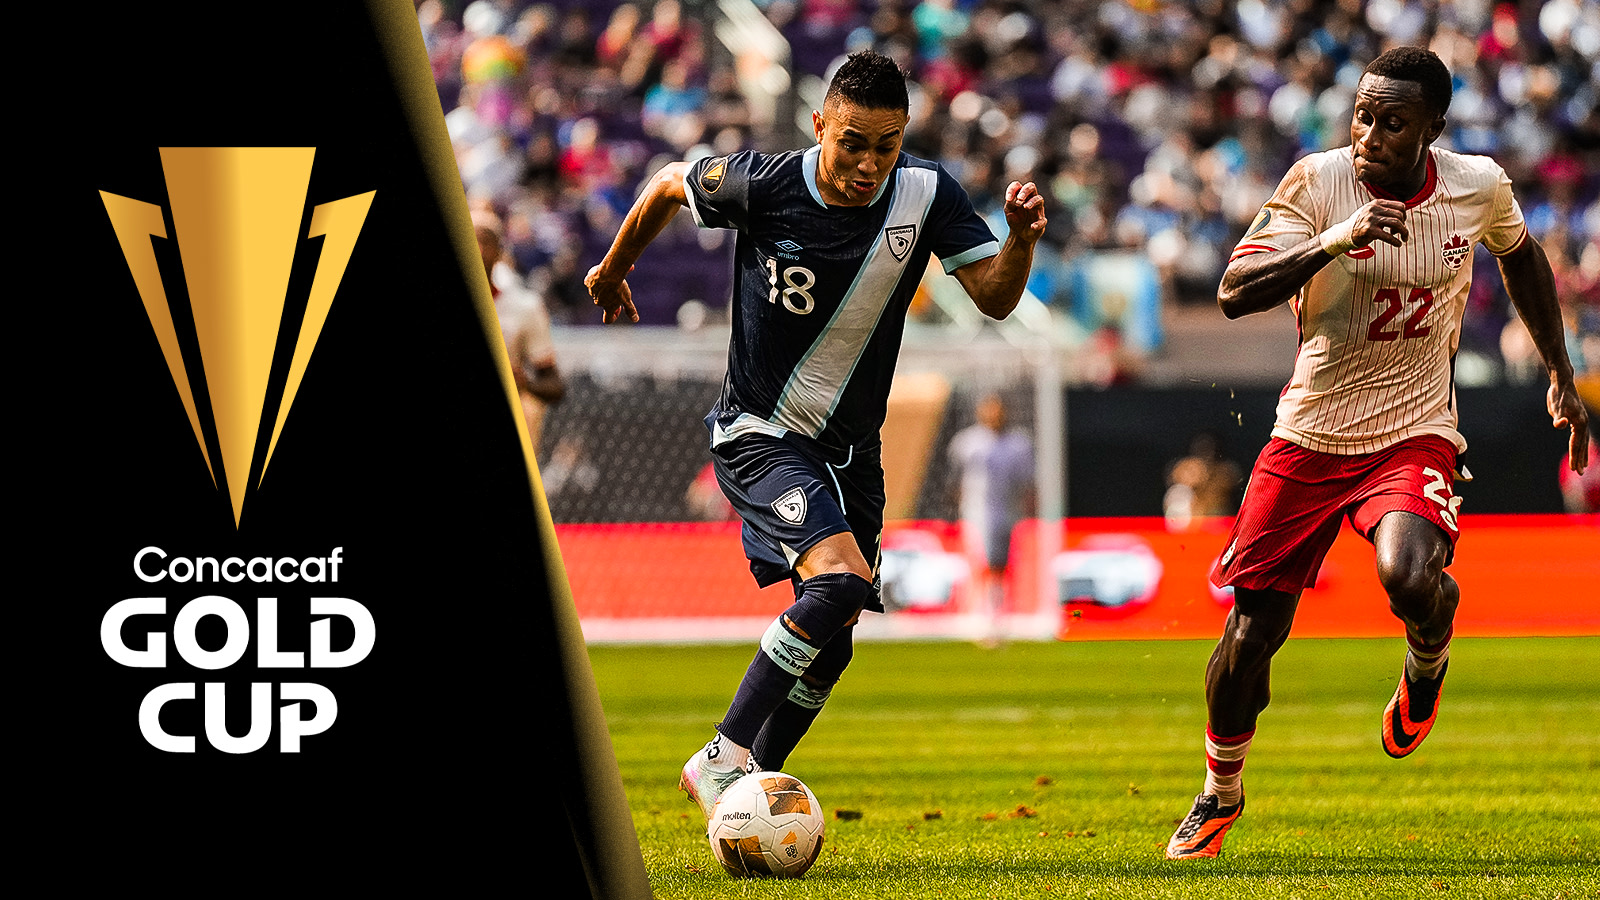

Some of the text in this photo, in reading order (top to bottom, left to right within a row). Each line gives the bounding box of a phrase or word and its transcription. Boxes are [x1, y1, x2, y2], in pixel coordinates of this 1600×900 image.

[777, 251, 800, 261] umbro
[1442, 247, 1470, 257] CANADA
[766, 259, 816, 315] 18
[1367, 288, 1434, 342] 22
[722, 811, 752, 821] molten
